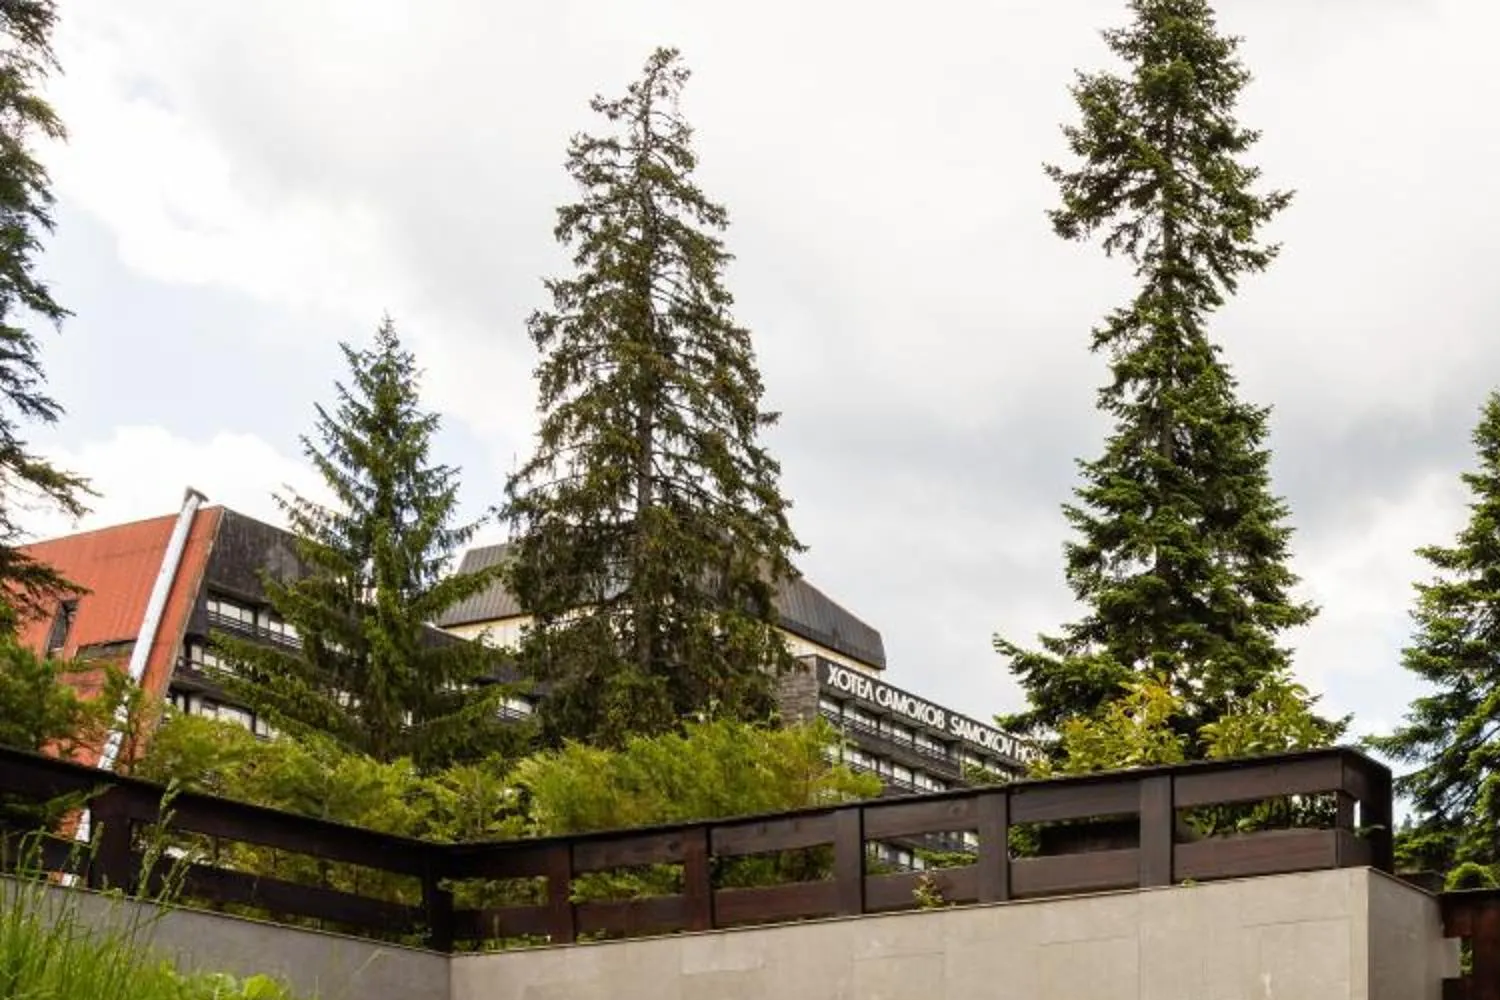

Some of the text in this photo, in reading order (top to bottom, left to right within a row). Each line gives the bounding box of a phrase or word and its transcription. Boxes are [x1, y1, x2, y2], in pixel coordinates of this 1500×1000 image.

[828, 664, 945, 729] ХОТЕЛ САМОКОВ
[950, 715, 1013, 756] SAMOKOV
